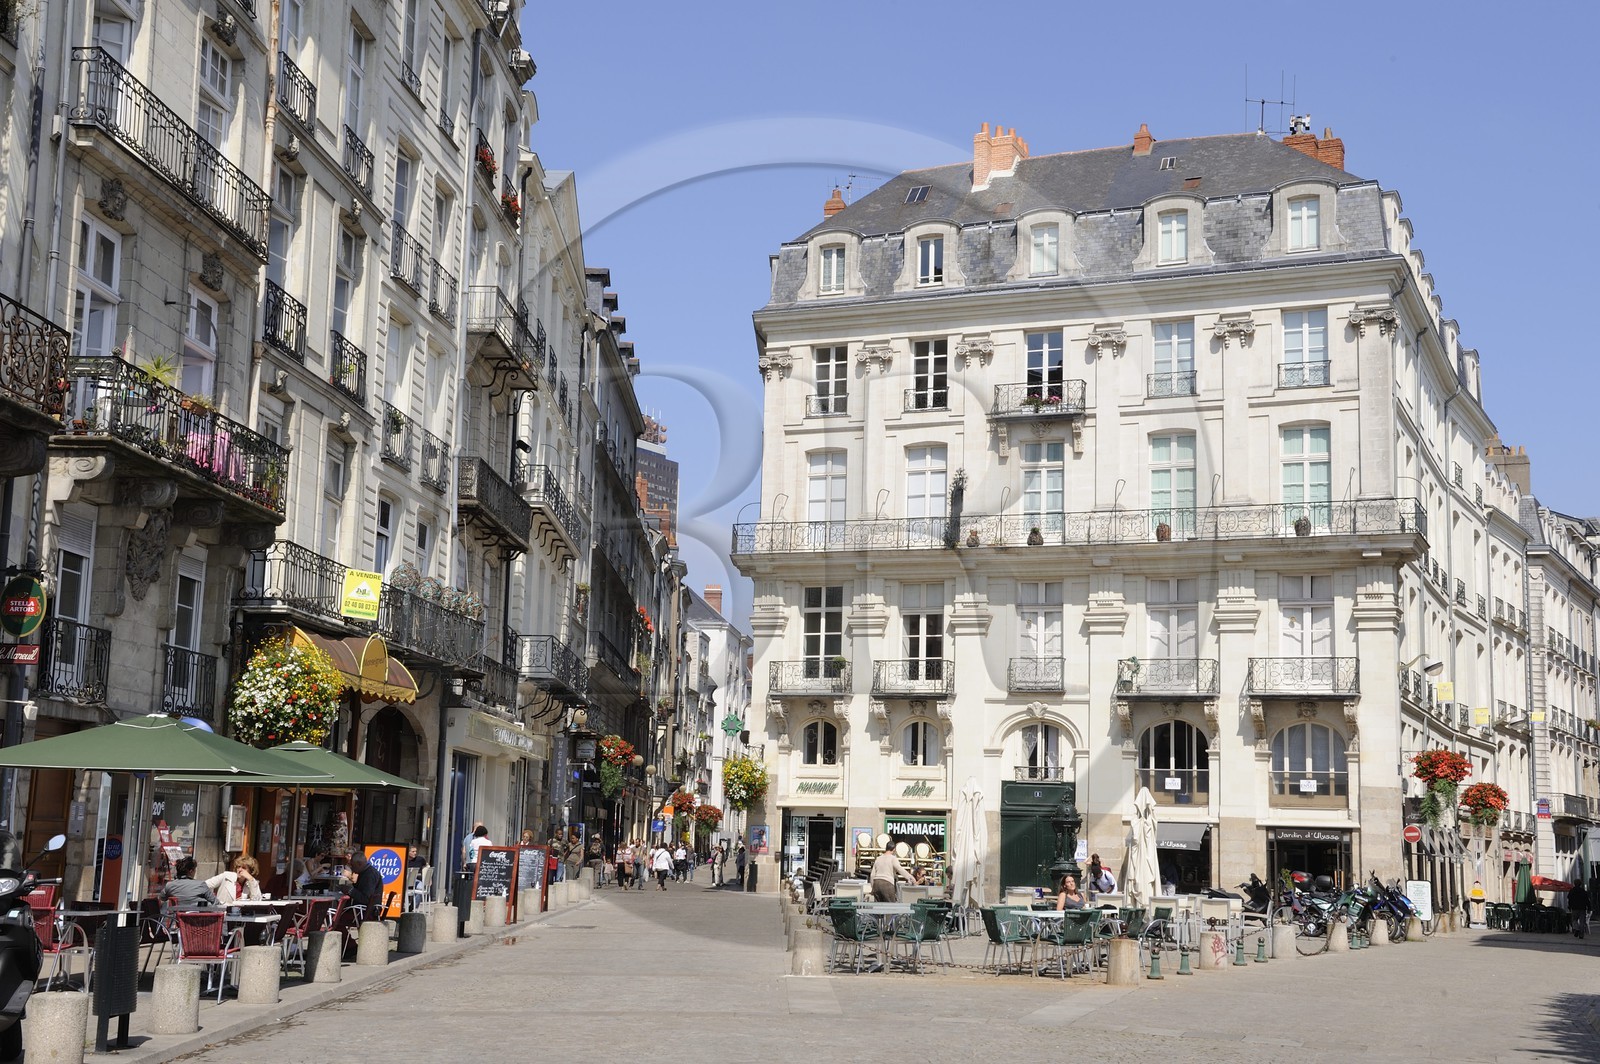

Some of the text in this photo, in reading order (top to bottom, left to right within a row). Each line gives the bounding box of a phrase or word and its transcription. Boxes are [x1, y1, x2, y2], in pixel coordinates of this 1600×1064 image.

[356, 571, 381, 580] VENDRE
[796, 781, 839, 794] PHARMACIE
[887, 822, 945, 836] PHARMACIE
[1278, 831, 1339, 840] Jardin d'Ulysse
[370, 853, 398, 866] Saint
